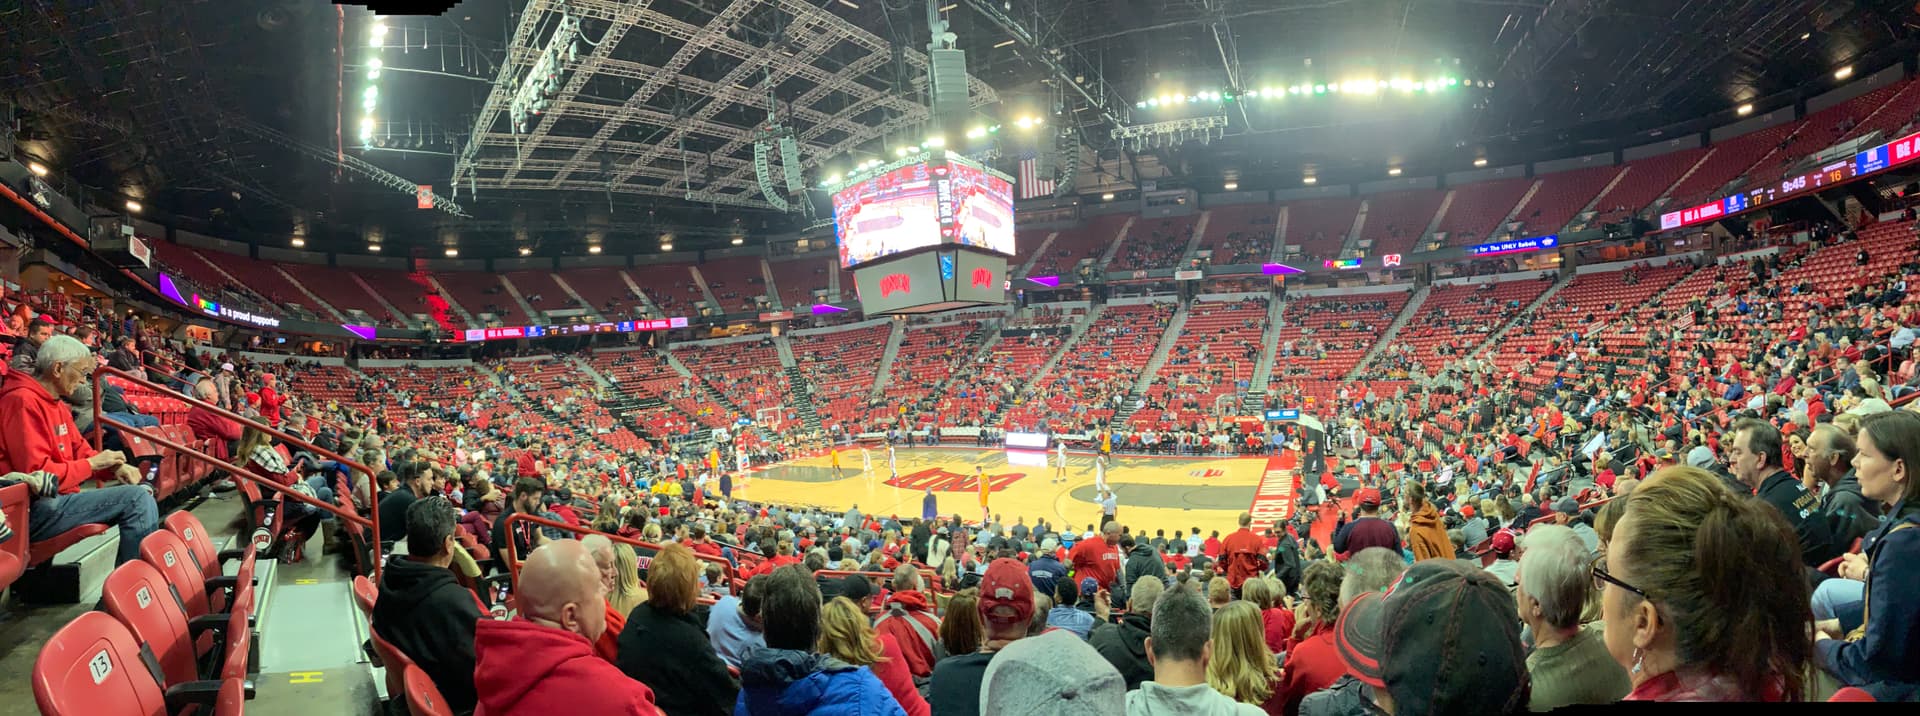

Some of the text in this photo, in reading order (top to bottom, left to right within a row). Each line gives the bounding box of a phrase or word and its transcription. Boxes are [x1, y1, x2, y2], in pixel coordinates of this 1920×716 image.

[1896, 140, 1911, 159] BE
[1782, 176, 1806, 193] 9:45
[1829, 170, 1842, 182] 16
[1753, 195, 1762, 206] 17
[220, 305, 227, 315] is
[227, 309, 233, 317] a
[233, 310, 250, 322] proud
[93, 655, 108, 681] 13
